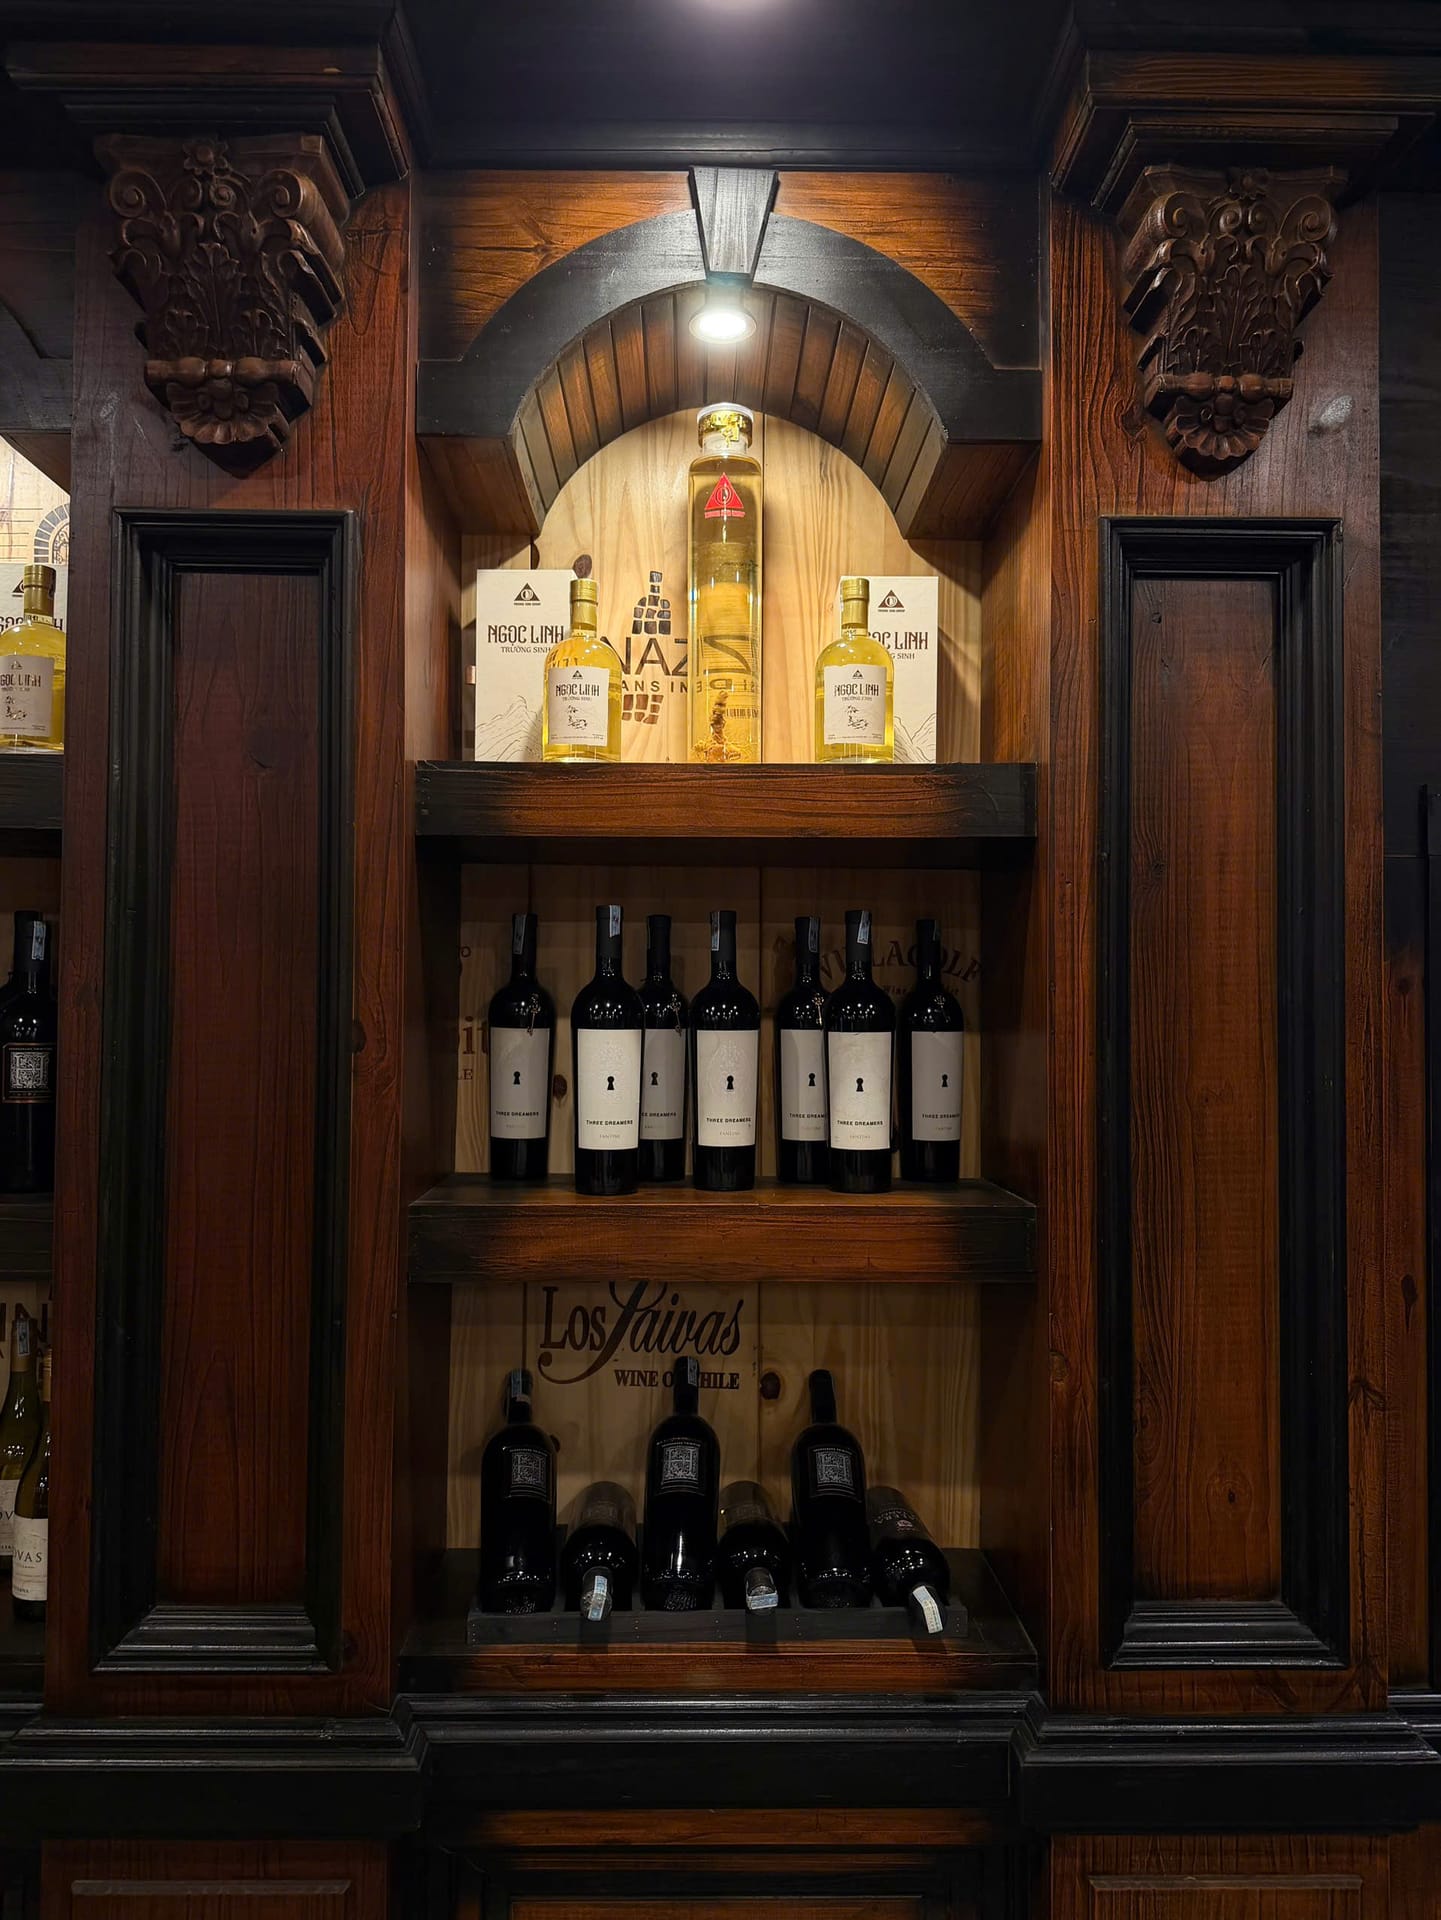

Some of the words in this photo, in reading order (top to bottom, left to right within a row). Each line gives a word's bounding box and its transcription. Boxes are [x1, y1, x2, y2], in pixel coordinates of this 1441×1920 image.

[488, 625, 527, 646] NGỌC
[531, 625, 564, 643] LINH
[895, 632, 928, 649] LINH
[860, 683, 879, 696] LINH
[614, 1369, 659, 1388] WINE
[662, 1371, 674, 1388] O
[699, 1372, 740, 1389] HILE
